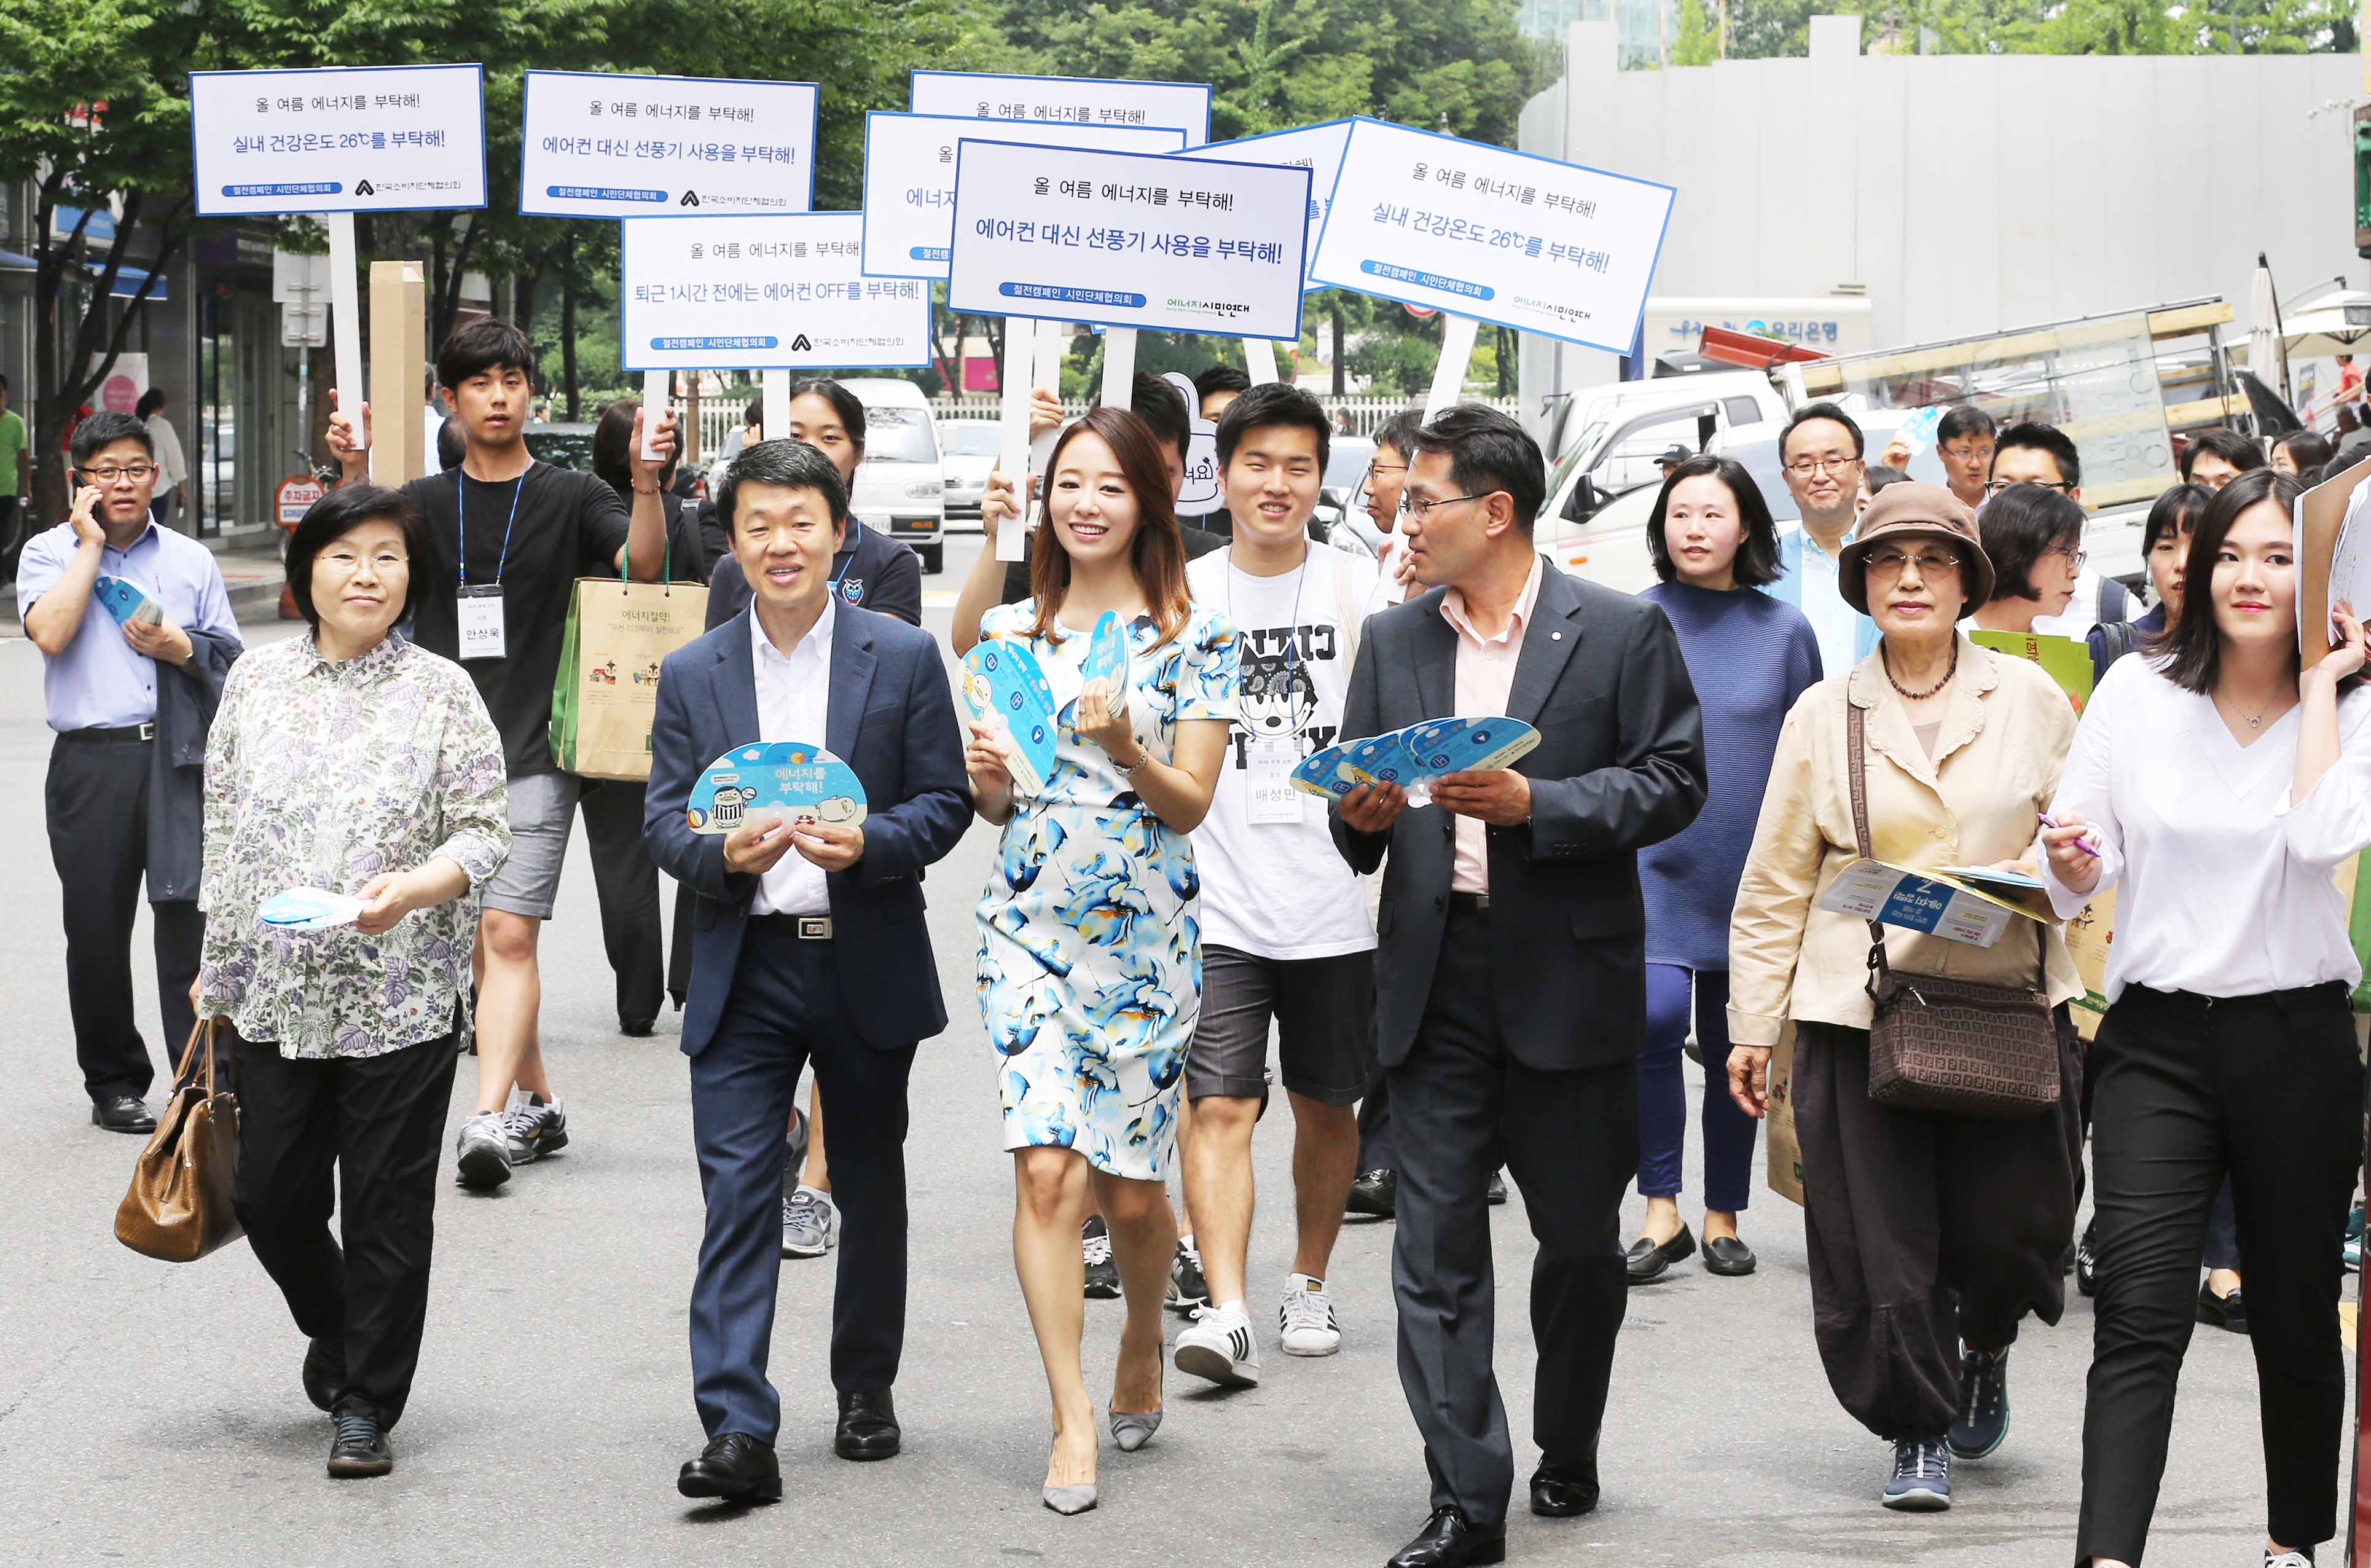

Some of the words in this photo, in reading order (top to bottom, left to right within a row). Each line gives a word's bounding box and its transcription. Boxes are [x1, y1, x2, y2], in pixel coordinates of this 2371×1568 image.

[256, 98, 269, 112] 올
[278, 98, 304, 111] 여름
[312, 96, 367, 110] 에너지를
[375, 93, 420, 108] 부탁해!
[590, 101, 603, 116] 올
[611, 103, 637, 117] 여름
[646, 104, 701, 120] 에너지를
[708, 107, 753, 122] 부탁해!
[976, 101, 990, 117] 올
[999, 103, 1026, 119] 여름
[1034, 106, 1091, 123] 에너지를
[1098, 109, 1145, 125] 부탁해!
[233, 136, 264, 153] 실내
[270, 134, 335, 152] 건강온도
[391, 130, 444, 147] 부탁해!
[543, 136, 590, 154] 에어컨
[597, 139, 628, 156] 대신
[634, 141, 681, 159] 선풍기
[688, 143, 736, 162] 사용을
[741, 146, 794, 164] 부탁해!
[939, 146, 953, 162] 올
[906, 187, 955, 208] 에너
[1034, 178, 1050, 195] 올
[1060, 180, 1092, 198] 여름
[1102, 184, 1169, 205] 에너지를
[1178, 190, 1233, 211] 부탁해!
[1413, 163, 1427, 181] 올
[1436, 169, 1466, 189] 여름
[1475, 178, 1535, 205] 에너지를
[1543, 192, 1596, 219] 부탁해!
[976, 219, 1034, 242] 에어컨
[1042, 224, 1080, 246] 대신
[1086, 228, 1145, 253] 선풍기
[1151, 234, 1211, 257] 사용을
[1217, 239, 1282, 264] 부탁해!
[1373, 203, 1409, 227] 실내
[1413, 211, 1485, 243] 건강온도
[1547, 241, 1610, 273] 부탁해!
[691, 243, 704, 259] 올
[713, 243, 741, 258] 여름
[750, 243, 807, 258] 에너지를
[816, 241, 858, 257] 부탁해
[923, 248, 950, 259] 절전캠
[1373, 262, 1417, 281] 절전캠페인
[1421, 273, 1483, 297] 시민단체협의회
[635, 285, 666, 303] 퇴근
[670, 284, 708, 302] 1시간
[713, 283, 759, 302] 전에는
[764, 283, 810, 301] 에어컨
[816, 282, 861, 300] OFF를
[866, 281, 918, 300] 부탁해!
[1013, 284, 1061, 299] 절전캠페인
[1065, 288, 1133, 305] 시민단체협의회
[1167, 299, 1250, 317] 에너지시민연대
[662, 338, 703, 349] 절전캠페인
[707, 337, 766, 348] 시민단체협의회
[622, 610, 671, 622] 에너지절약!
[775, 768, 826, 780] 에너지를
[779, 781, 824, 794] 부탁해!
[1255, 788, 1296, 801] 배성민
